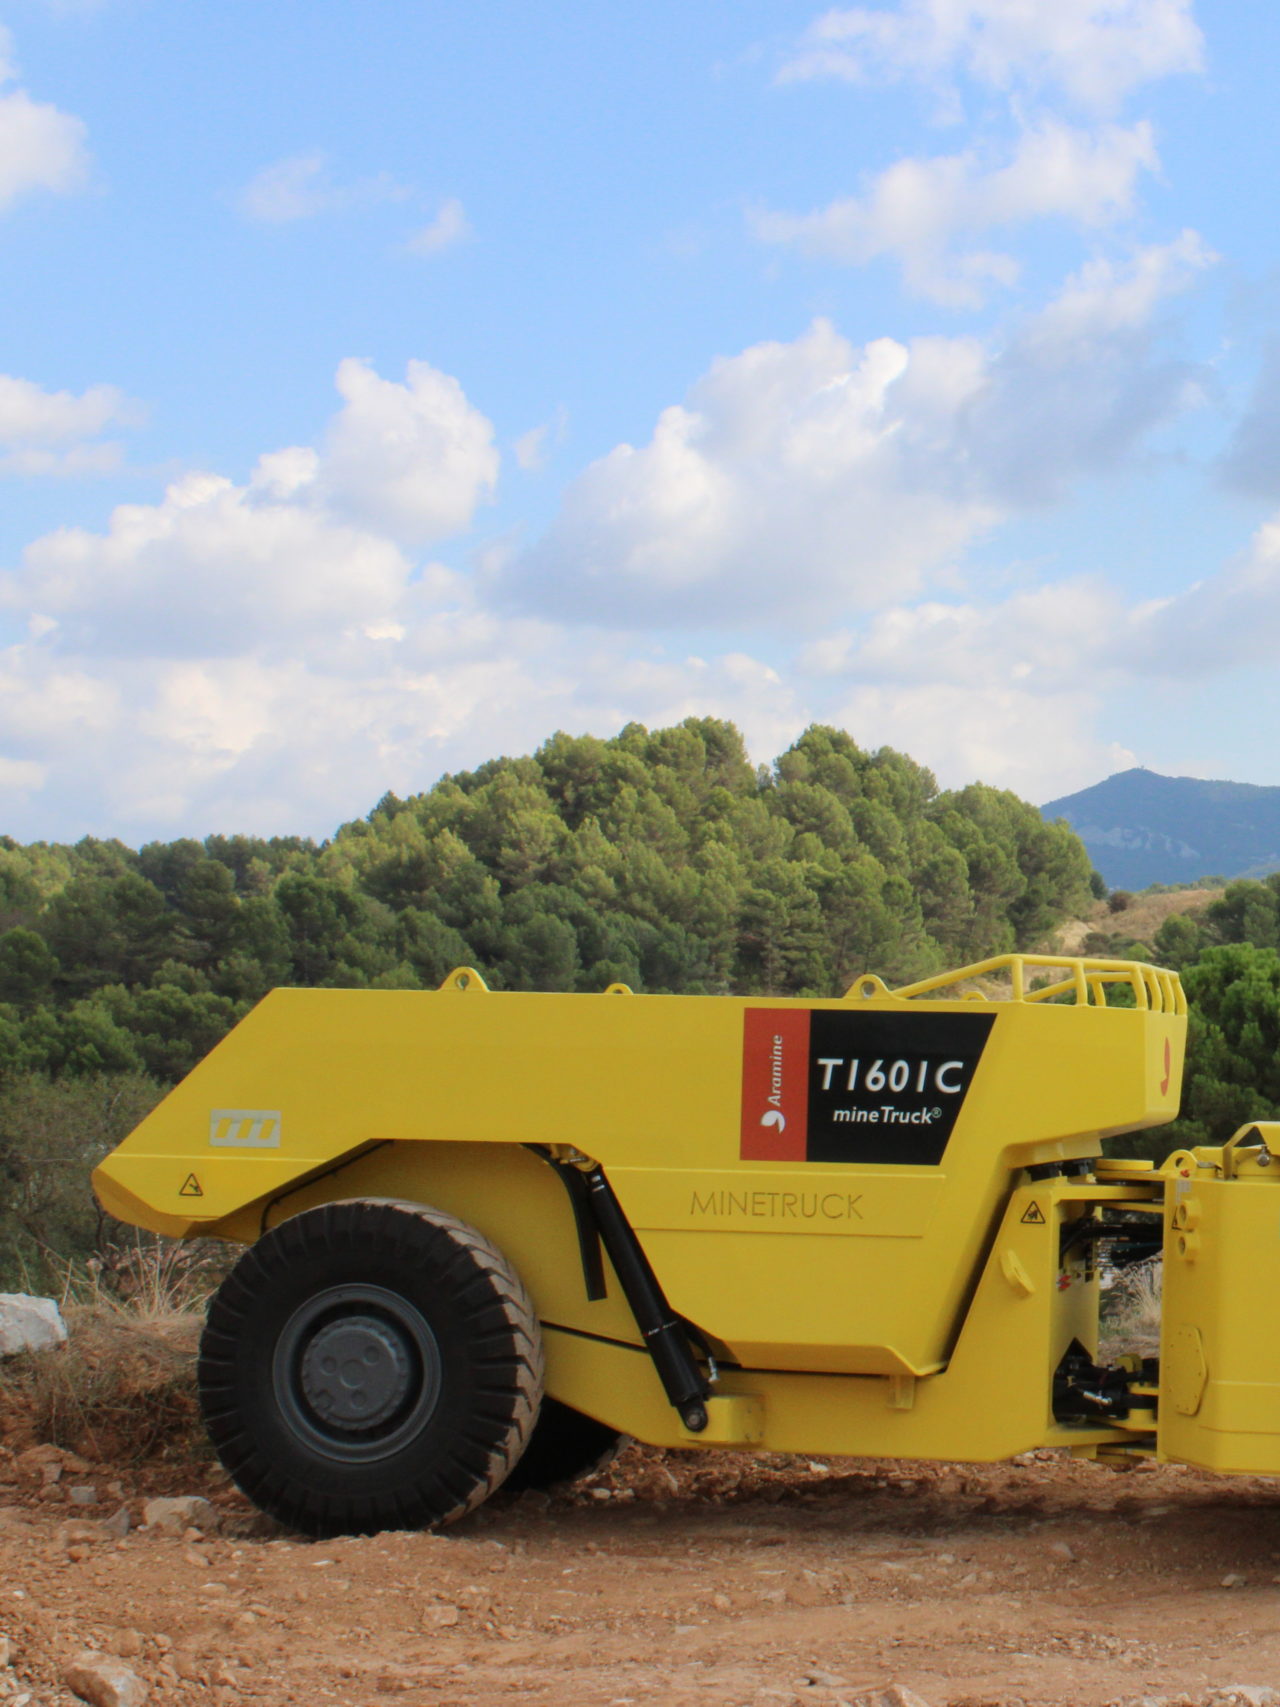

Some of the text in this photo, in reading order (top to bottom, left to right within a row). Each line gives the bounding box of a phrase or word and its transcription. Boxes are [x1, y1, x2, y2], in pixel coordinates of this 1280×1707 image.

[767, 1034, 784, 1107] Aramine
[817, 1058, 964, 1094] T1601C
[690, 1191, 864, 1220] MINETRUCK
